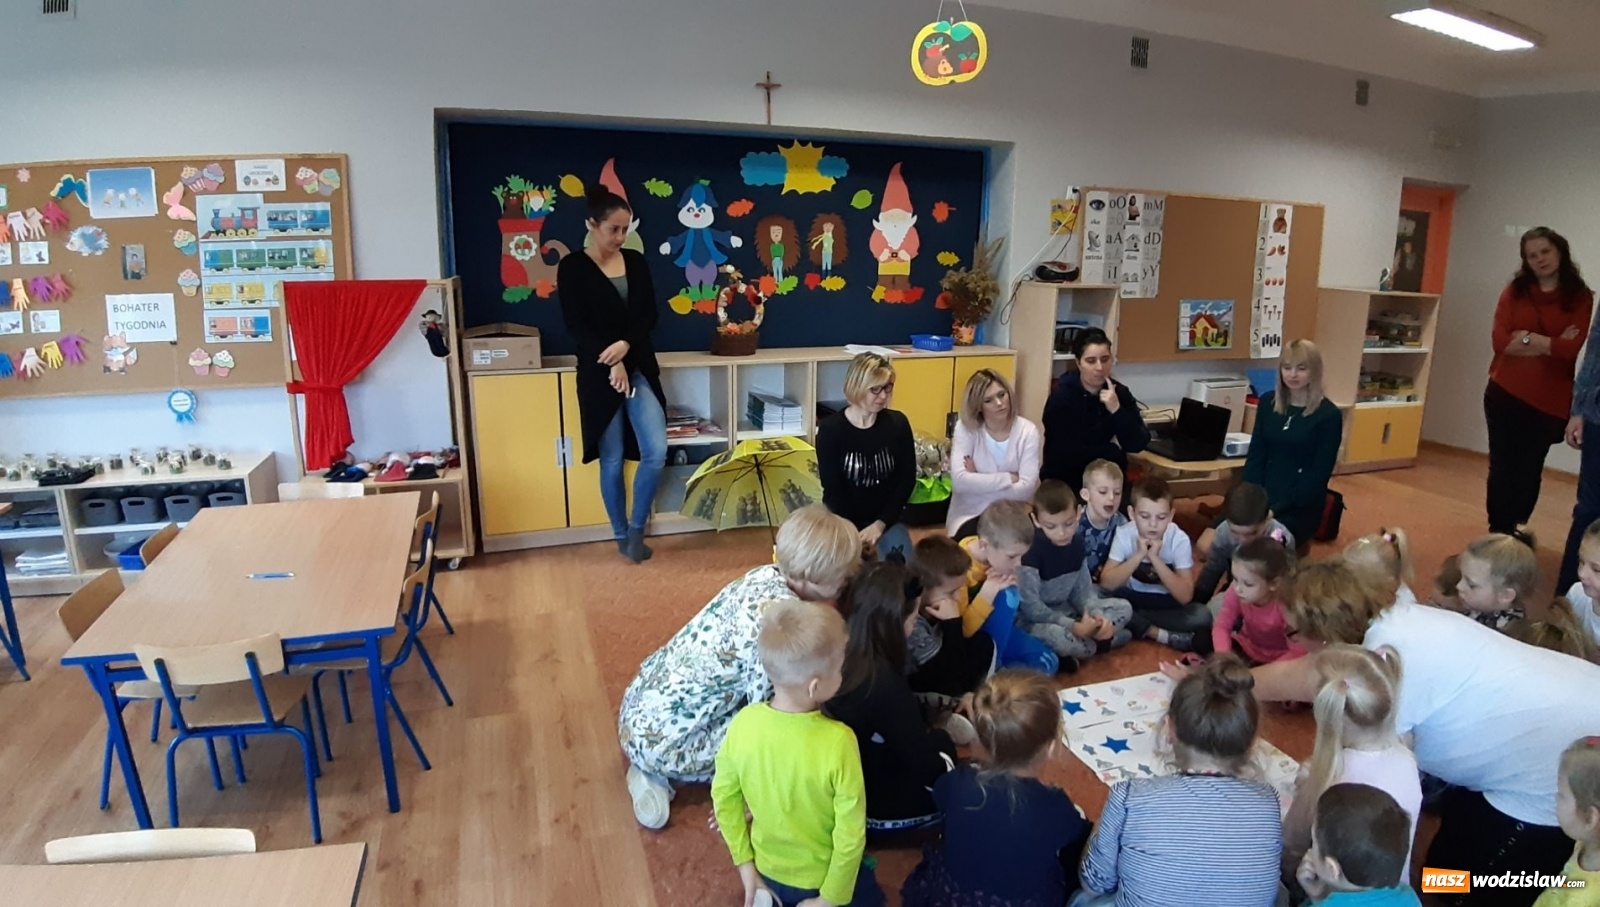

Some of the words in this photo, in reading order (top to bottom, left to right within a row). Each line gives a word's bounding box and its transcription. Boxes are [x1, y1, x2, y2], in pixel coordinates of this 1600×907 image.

[1143, 200, 1164, 211] mM
[1106, 232, 1123, 244] aA
[1143, 232, 1161, 245] dD
[1259, 236, 1266, 250] 2
[1256, 267, 1263, 281] 3
[112, 303, 160, 313] BOHATER
[1254, 299, 1261, 312] 4
[114, 320, 167, 331] TYGODNIA
[1253, 329, 1260, 342] 5
